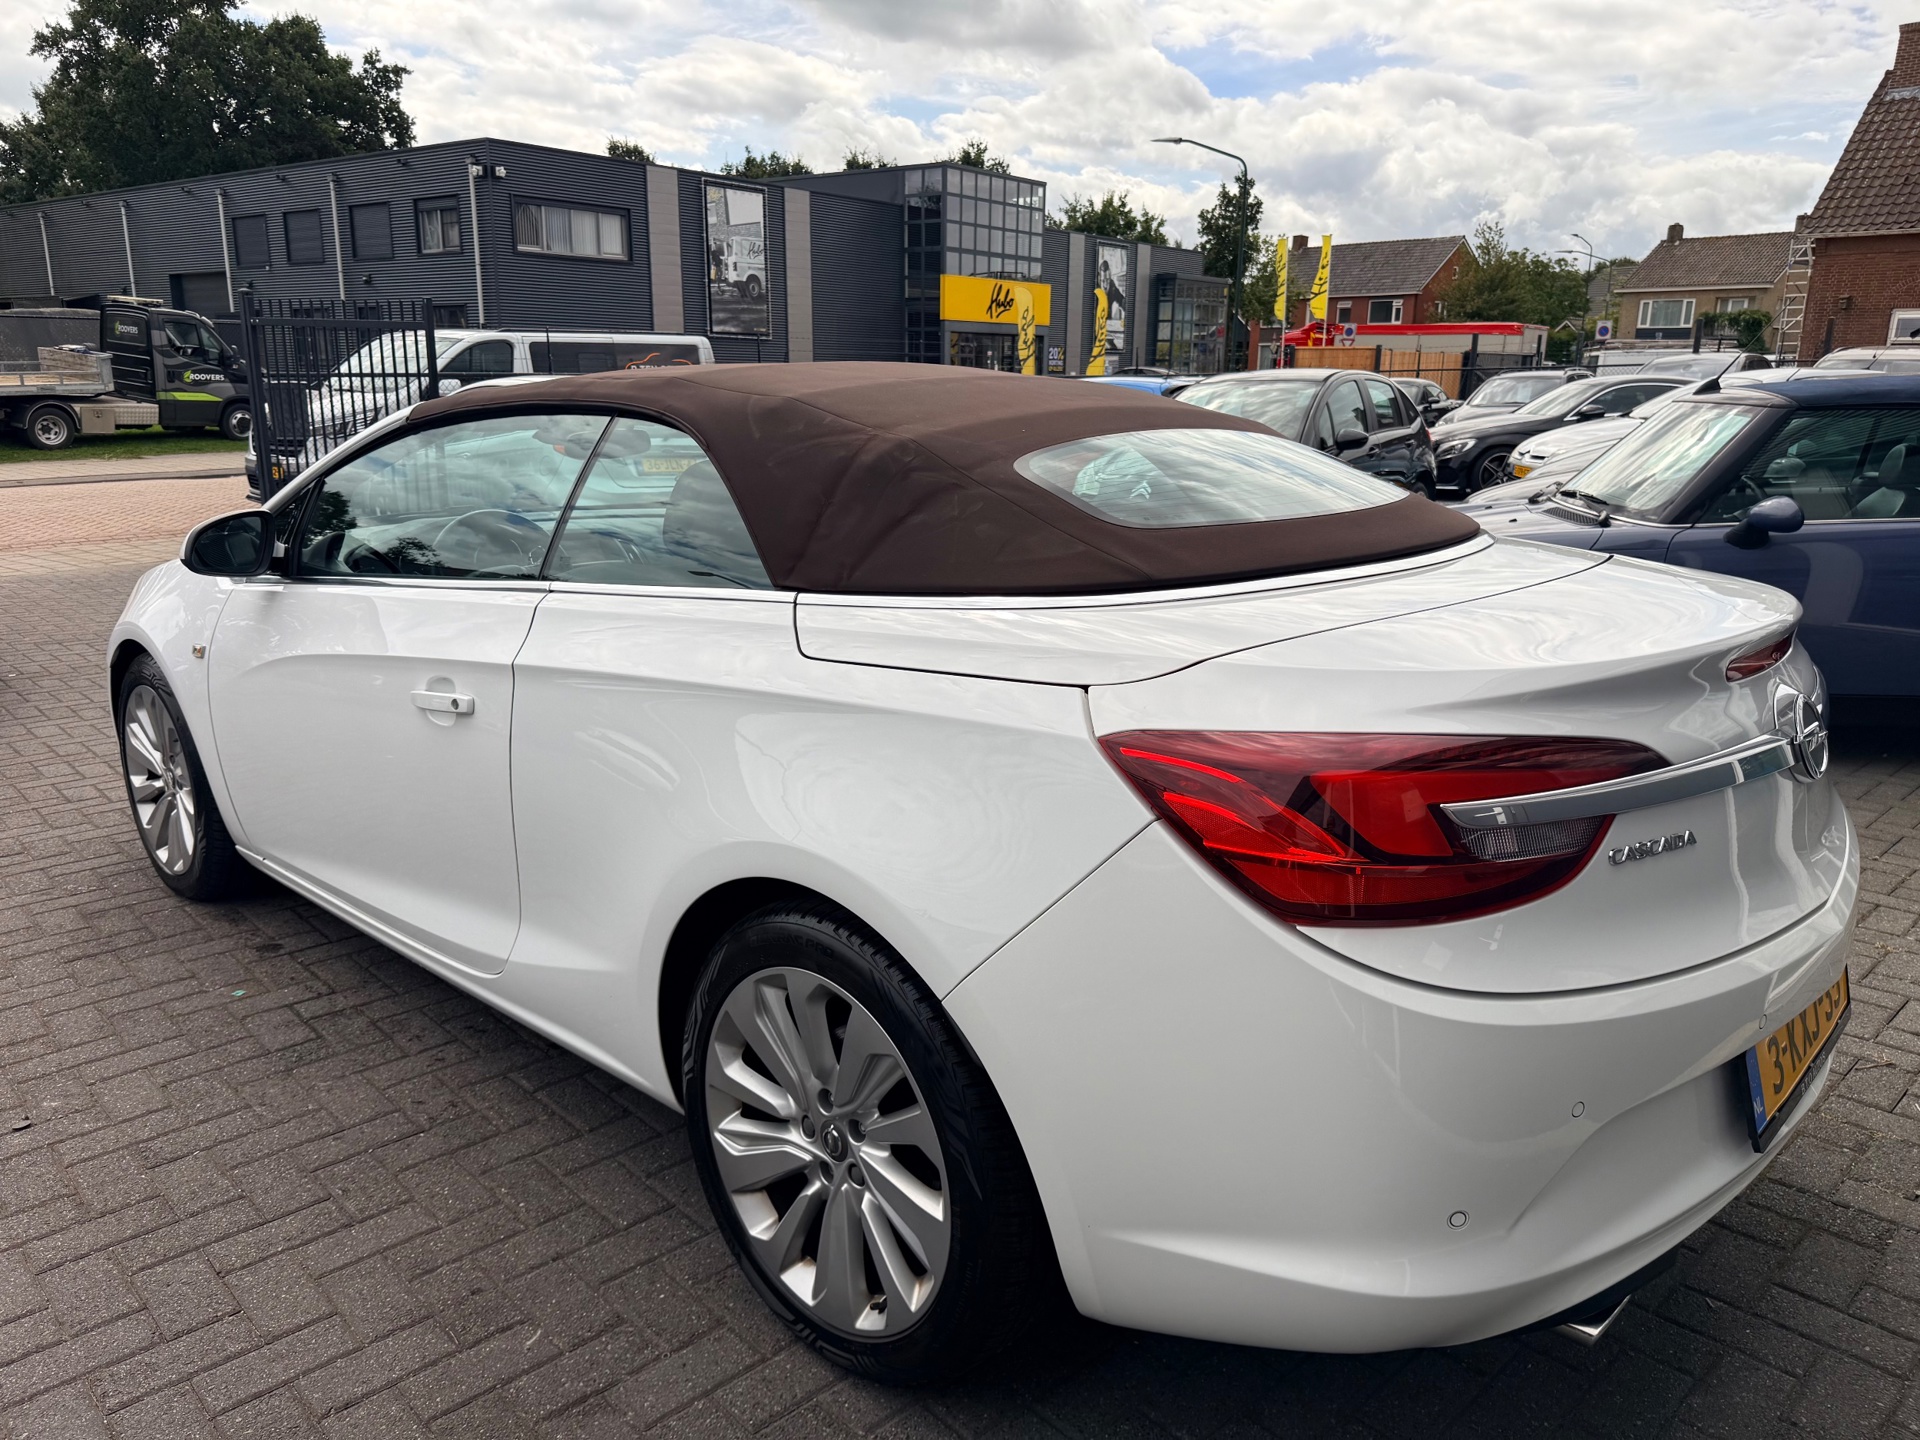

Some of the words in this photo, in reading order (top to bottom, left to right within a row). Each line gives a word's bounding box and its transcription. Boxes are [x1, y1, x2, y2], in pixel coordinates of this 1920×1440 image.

[986, 282, 1014, 319] Hubo
[118, 324, 139, 334] ROOVERS
[1048, 346, 1065, 360] 20%
[189, 373, 225, 381] ROOVERS
[1608, 830, 1698, 867] CASCADA
